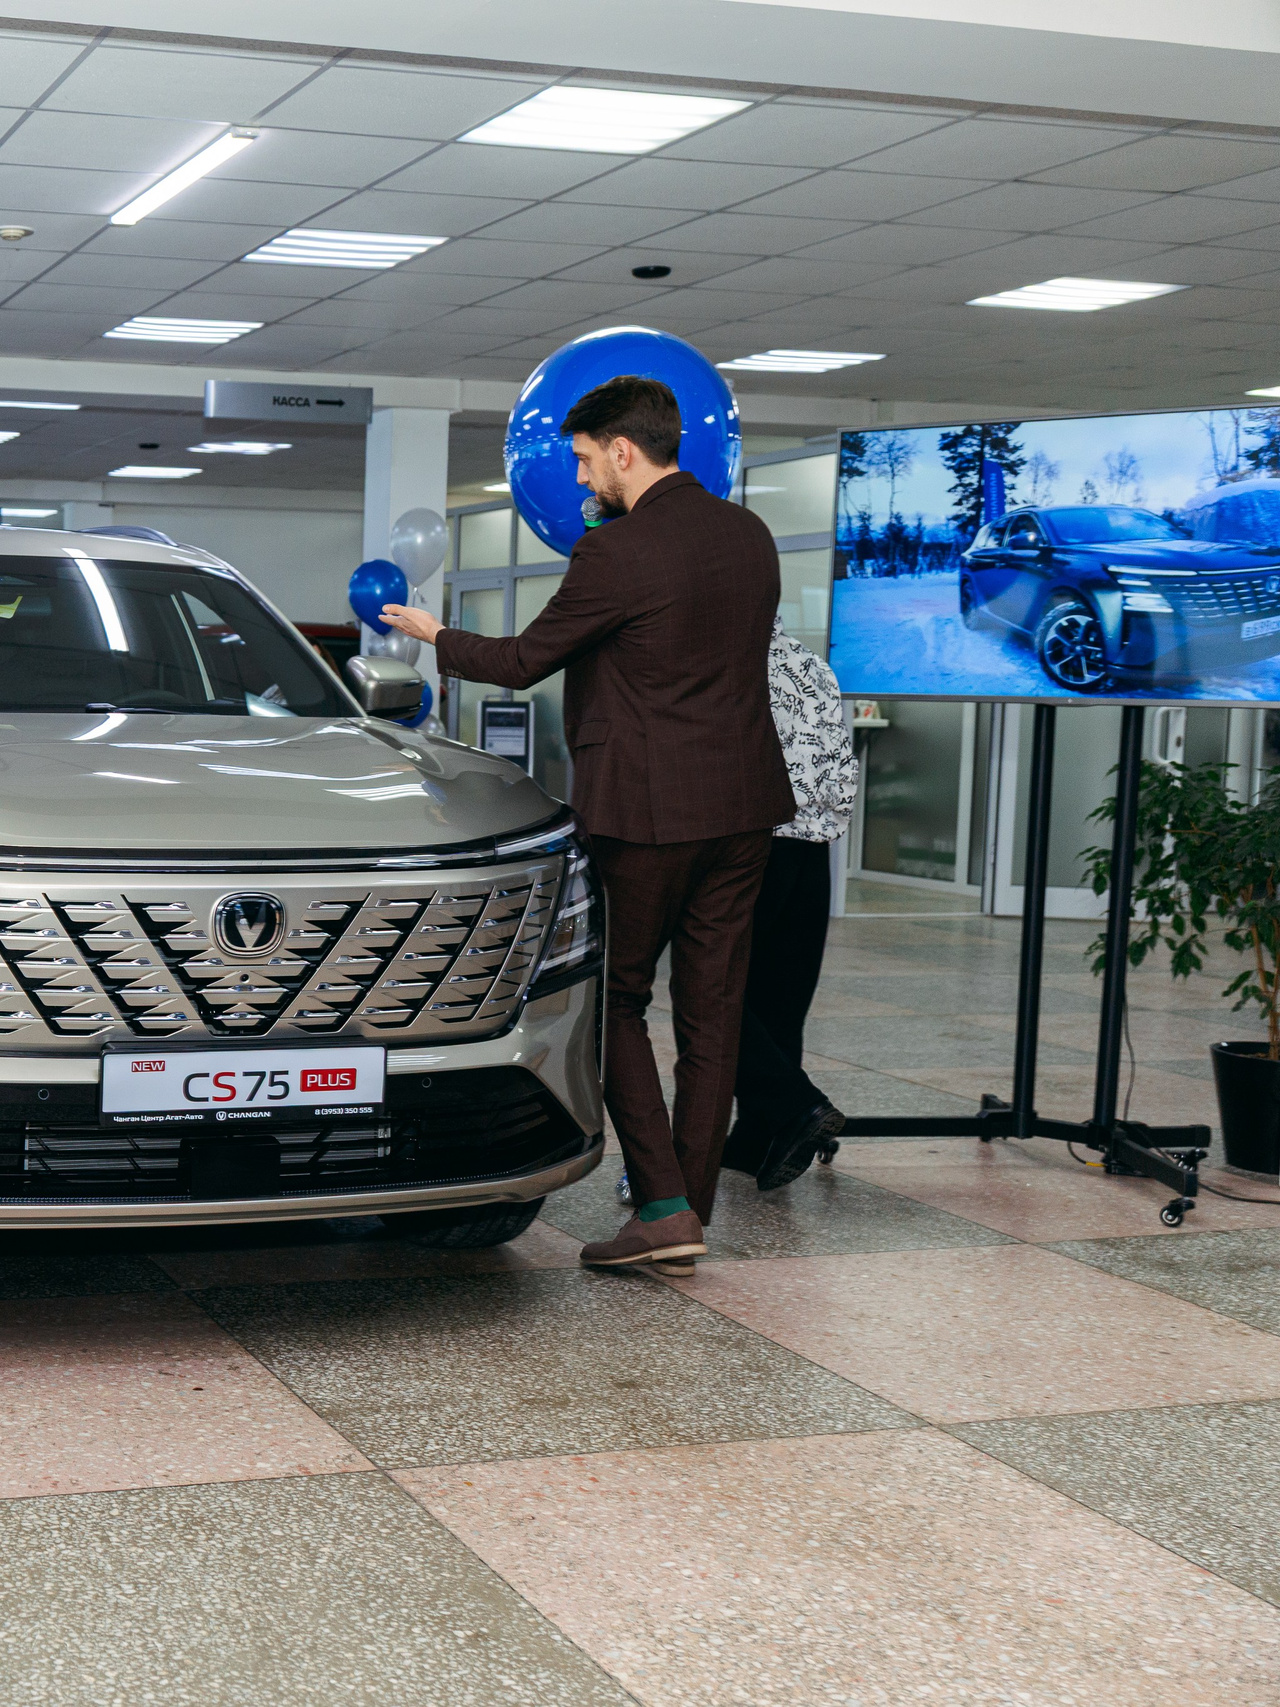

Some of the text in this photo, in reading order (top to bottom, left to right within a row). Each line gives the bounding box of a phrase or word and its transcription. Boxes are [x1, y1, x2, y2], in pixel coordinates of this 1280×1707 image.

[272, 396, 311, 407] КАССА
[132, 1061, 165, 1072] NEW
[183, 1070, 351, 1102] CS75 PLUS
[228, 1111, 271, 1119] CHANGAN
[321, 1107, 343, 1116] (3953)
[359, 1106, 373, 1114] 555
[165, 1113, 203, 1121] Агат-Авто
